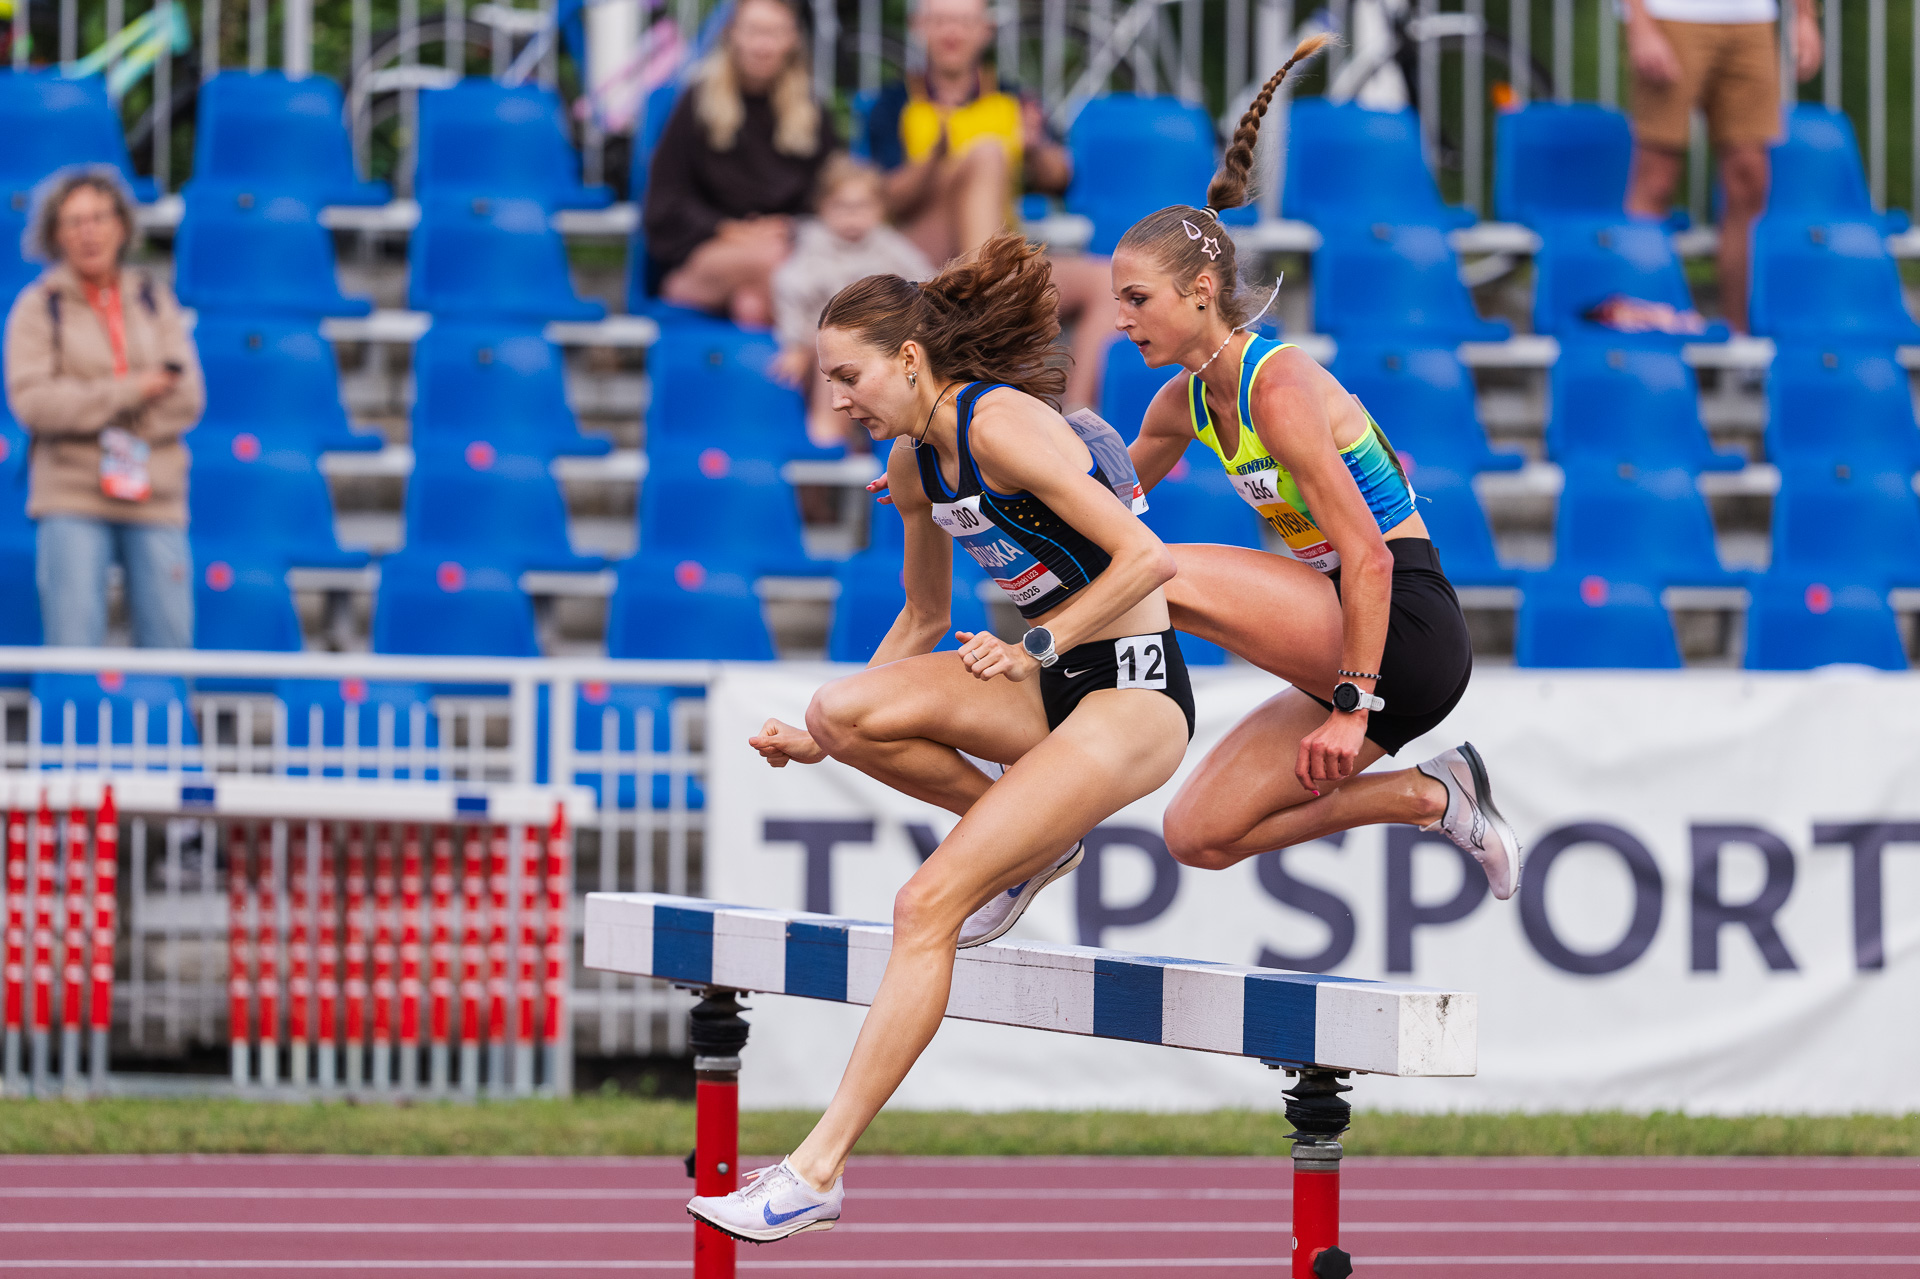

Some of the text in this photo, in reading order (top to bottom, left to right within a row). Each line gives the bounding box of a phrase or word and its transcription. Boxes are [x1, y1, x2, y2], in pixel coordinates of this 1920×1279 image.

[1244, 478, 1274, 500] 266
[951, 507, 979, 529] 300
[1027, 569, 1039, 581] U23
[1019, 585, 1041, 602] 2026
[1120, 643, 1164, 682] 12
[763, 819, 1920, 977] TP SPORT
